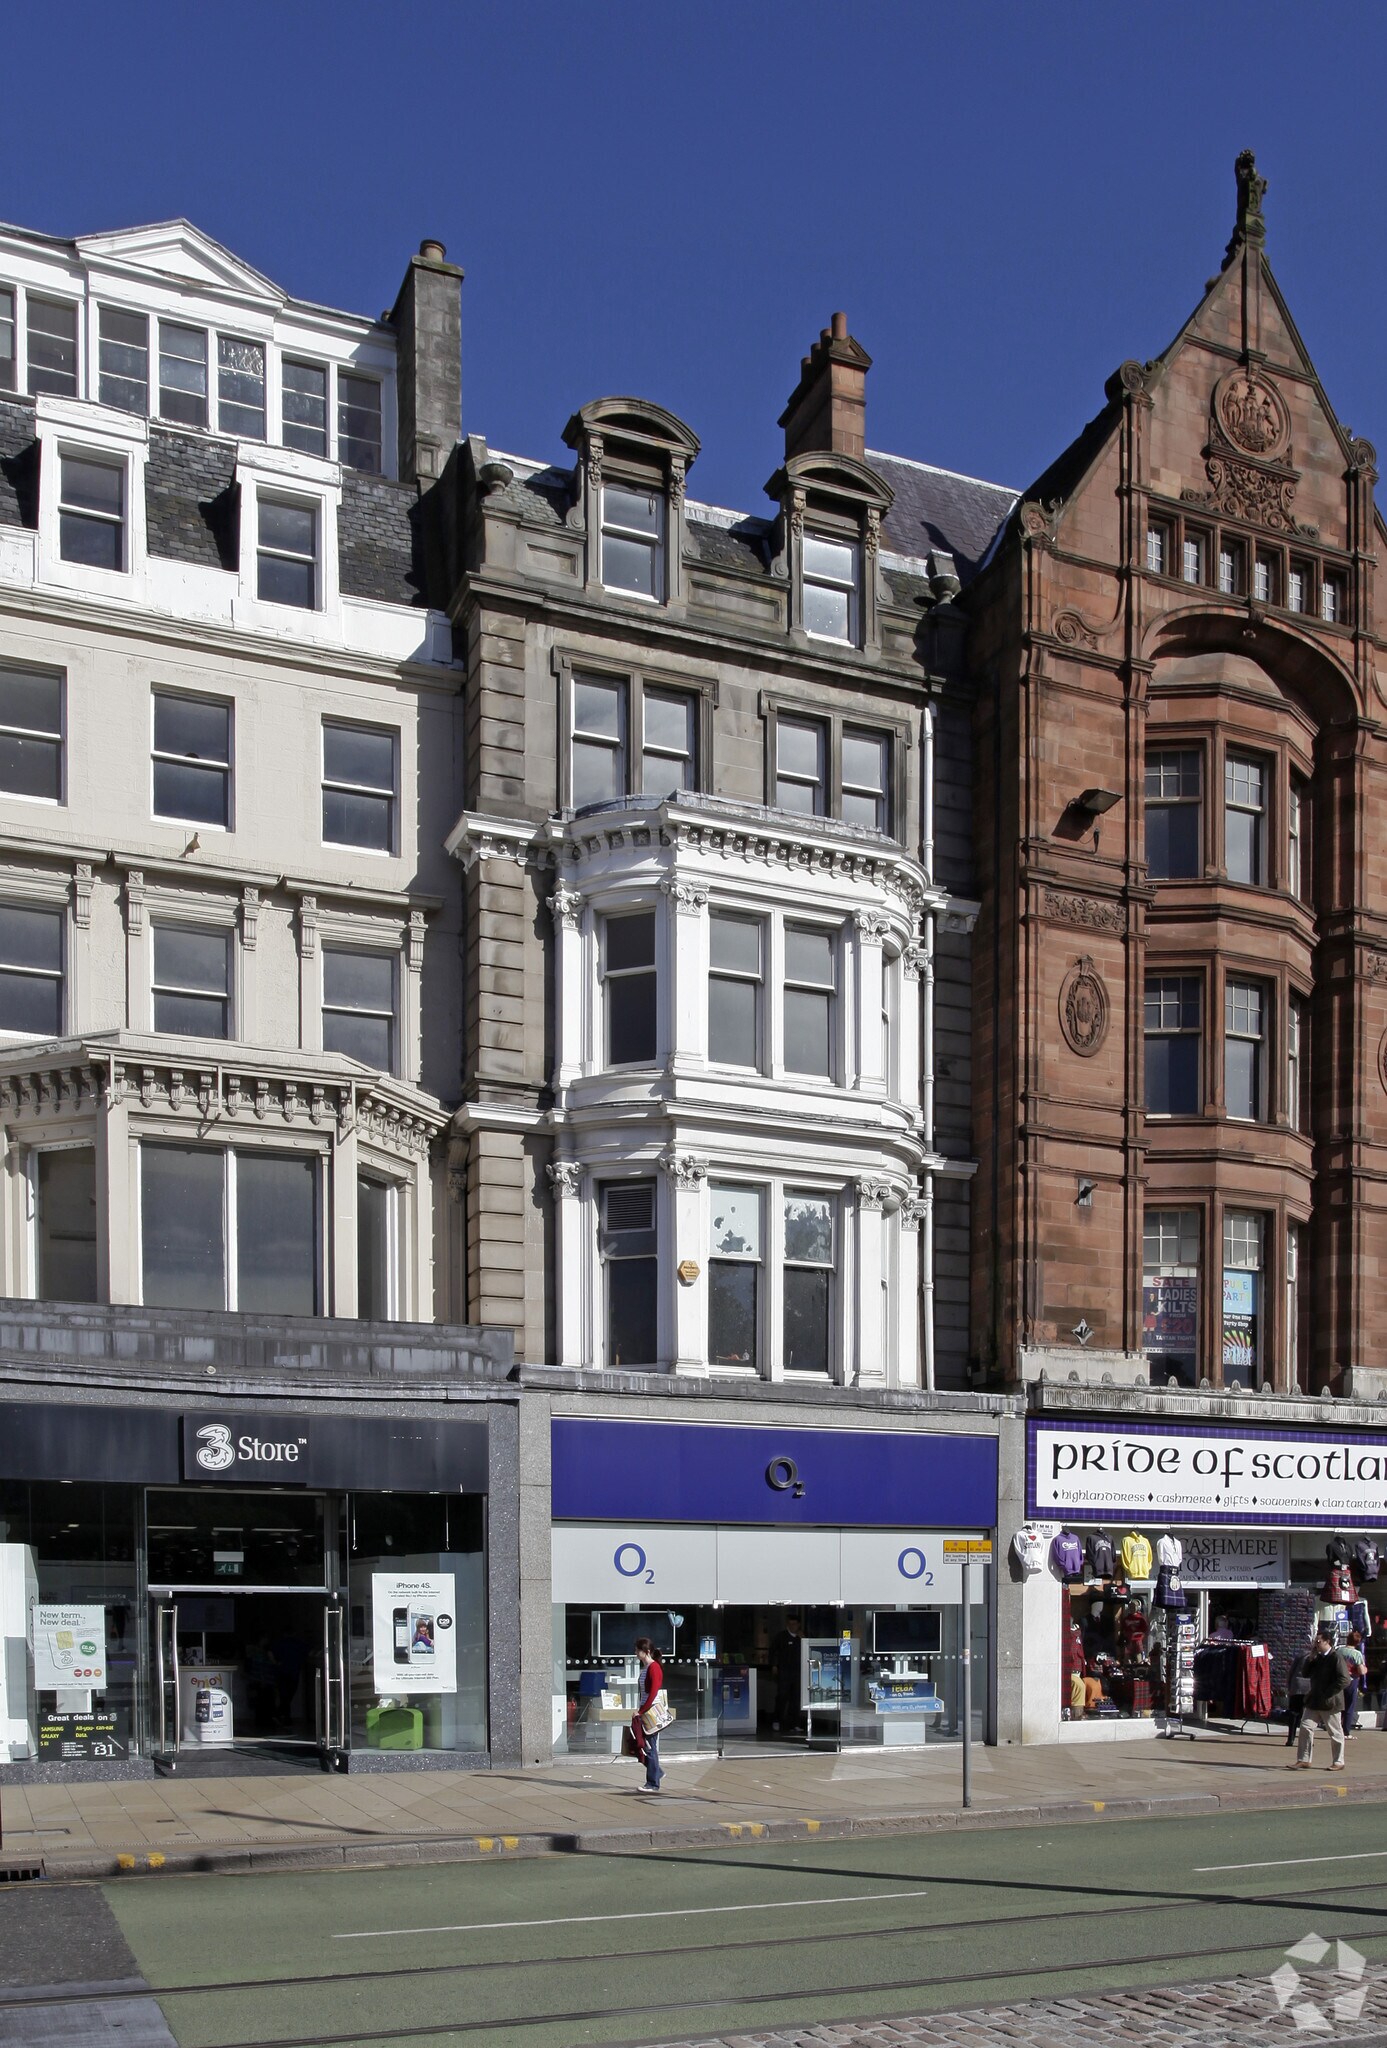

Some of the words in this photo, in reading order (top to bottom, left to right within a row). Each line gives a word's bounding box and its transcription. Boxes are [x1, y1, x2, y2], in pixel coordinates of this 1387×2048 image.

[1152, 1277, 1190, 1288] SALE
[1158, 1288, 1196, 1301] LADIES
[1157, 1301, 1196, 1313] KILTS
[196, 1423, 236, 1471] 3
[1192, 1447, 1244, 1488] of
[1252, 1448, 1387, 1481] scotla
[1156, 1493, 1212, 1504] cashmere
[1223, 1494, 1249, 1507] gifts
[1260, 1497, 1312, 1507] souvenirs
[1181, 1538, 1278, 1555] CASHMERE
[1179, 1558, 1220, 1572] TORE
[191, 1673, 223, 1690] enjoy
[48, 1714, 70, 1722] Great
[94, 1744, 113, 1756] £31
